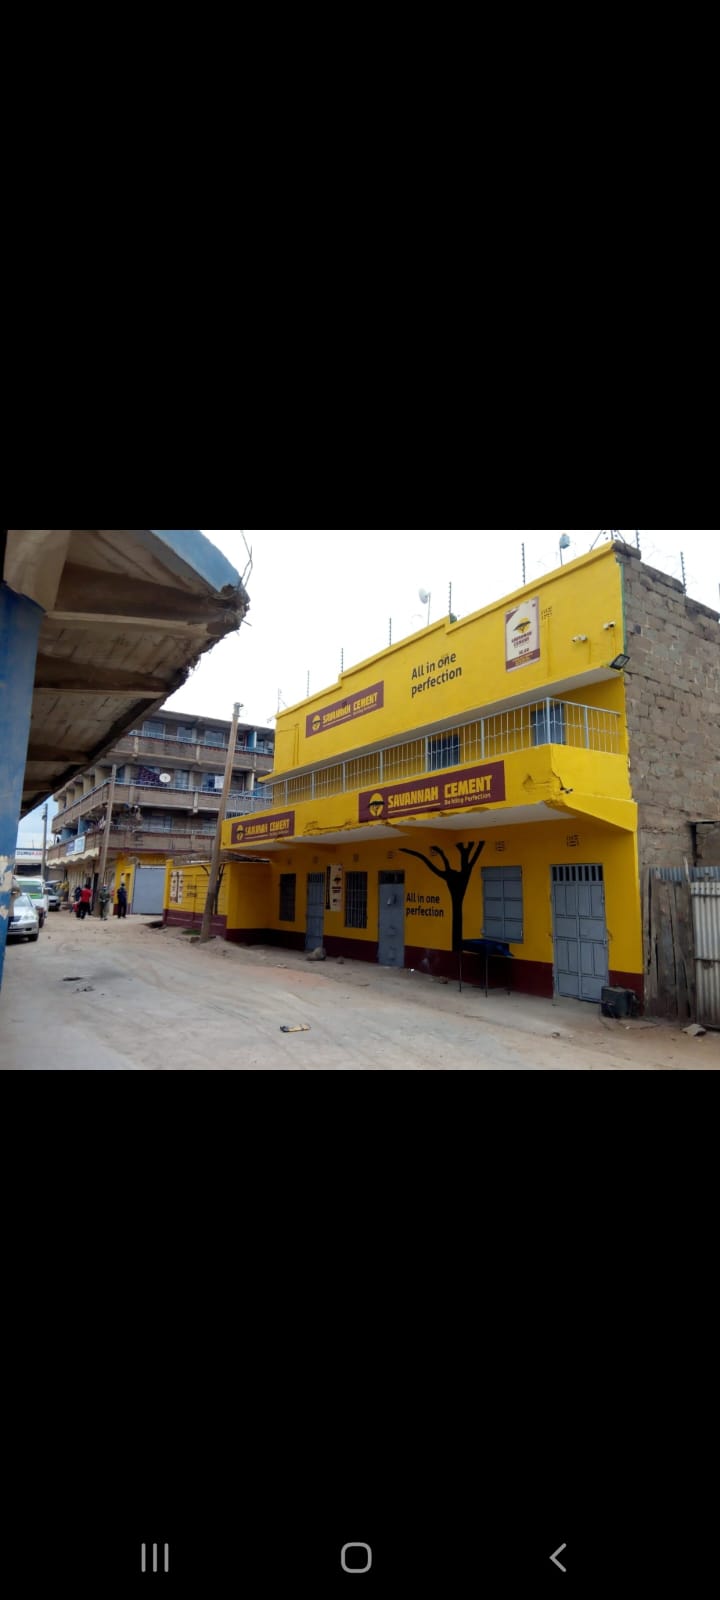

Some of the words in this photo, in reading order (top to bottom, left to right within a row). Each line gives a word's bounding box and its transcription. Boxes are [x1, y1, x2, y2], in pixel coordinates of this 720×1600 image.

[411, 664, 425, 681] All
[426, 660, 436, 674] in
[437, 652, 457, 669] one
[411, 666, 462, 699] perfection
[353, 691, 378, 711] CEMENT
[387, 786, 439, 808] SAVANNAH
[444, 774, 492, 798] CEMENT
[464, 793, 491, 802] Perfection
[269, 818, 290, 832] CEMENT
[406, 892, 416, 903] All
[417, 894, 425, 904] in
[425, 895, 441, 904] one
[406, 905, 444, 918] perfection
